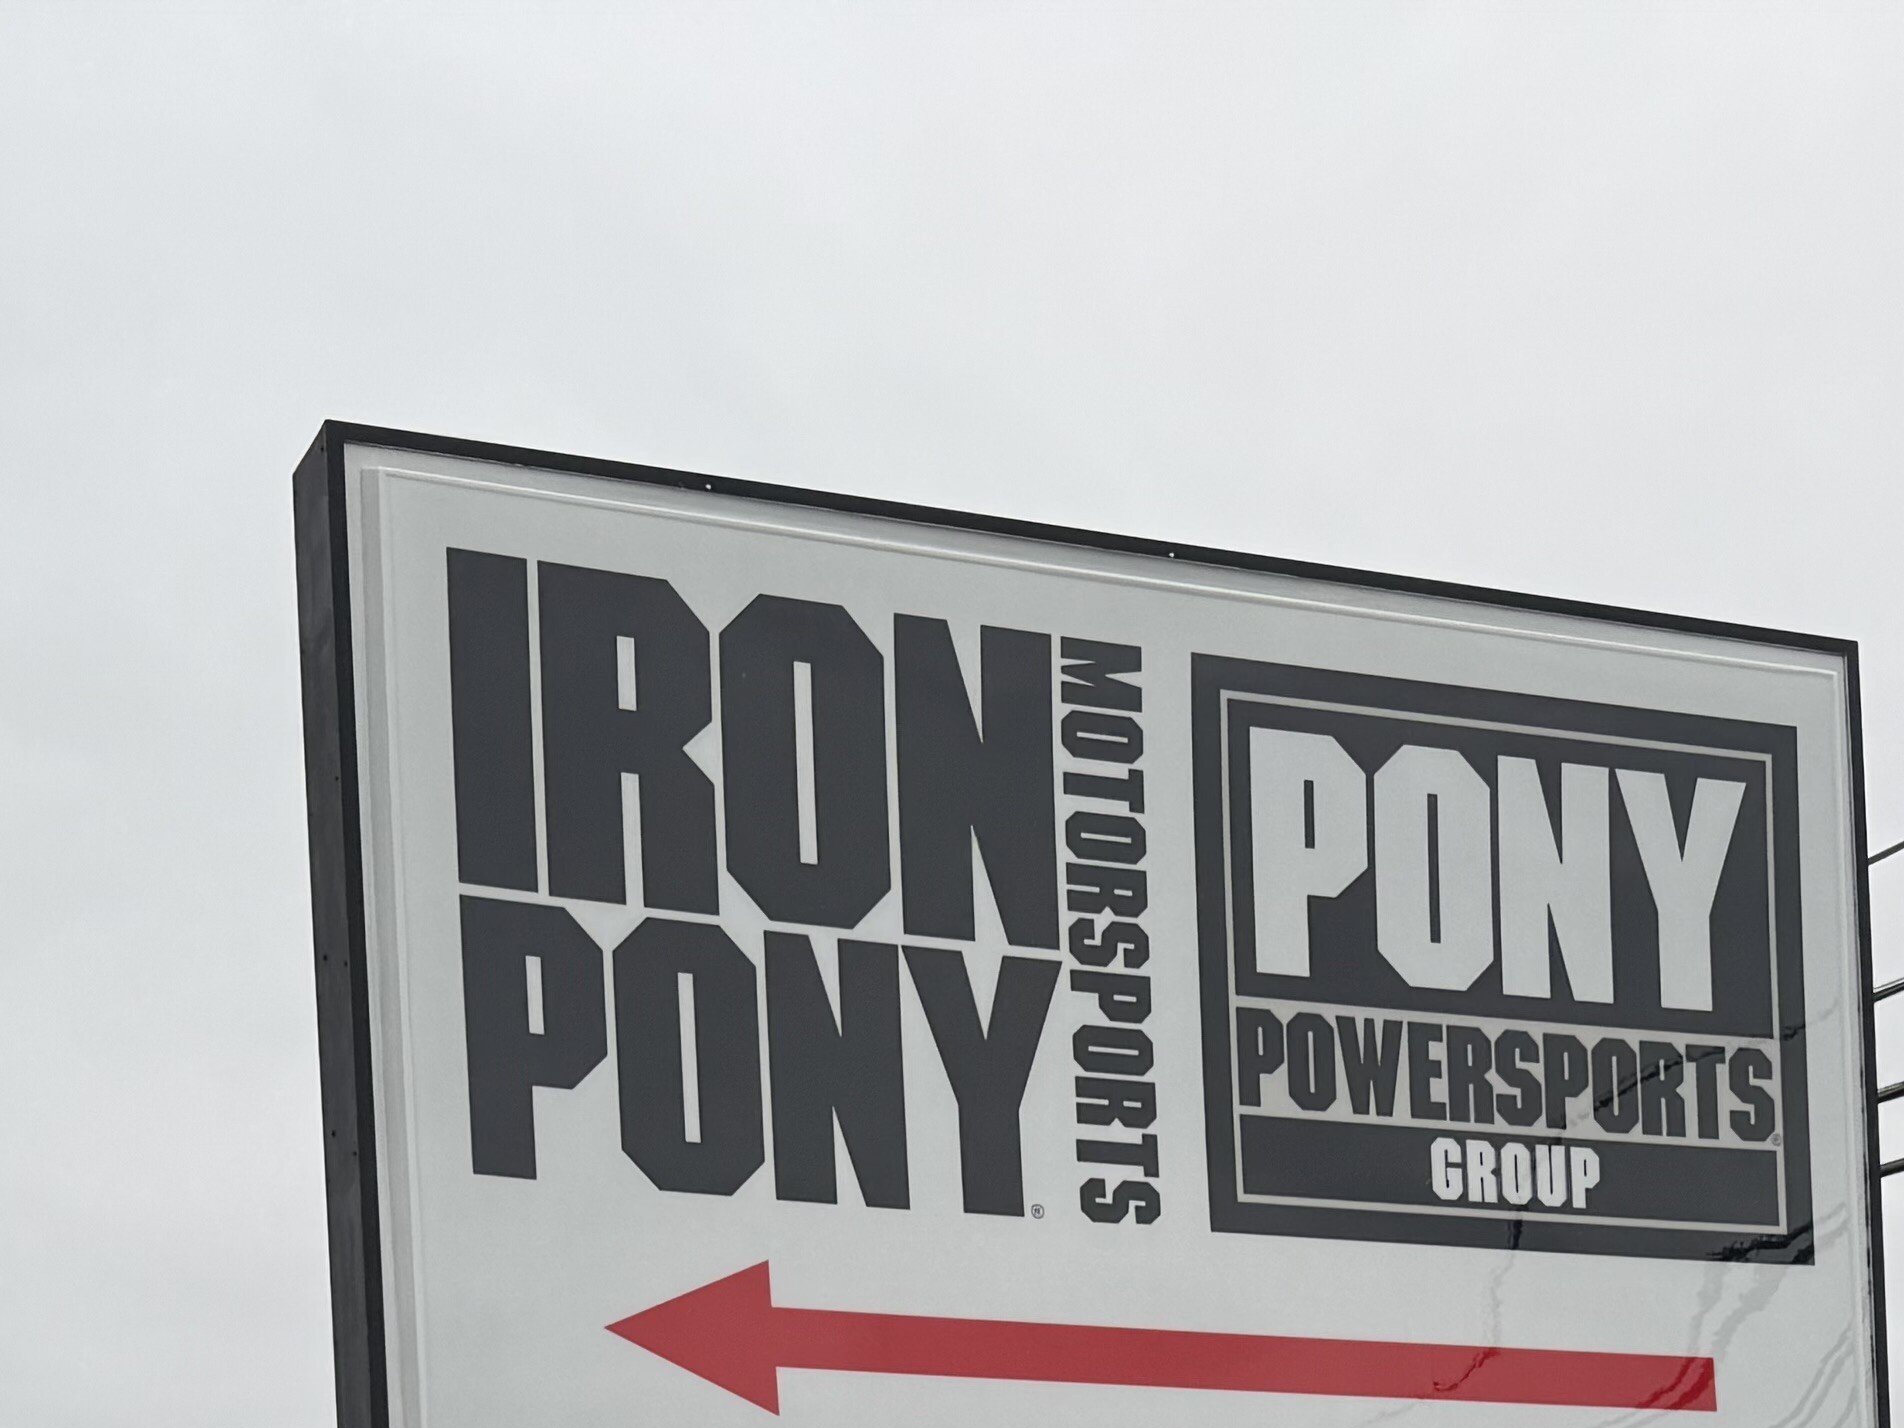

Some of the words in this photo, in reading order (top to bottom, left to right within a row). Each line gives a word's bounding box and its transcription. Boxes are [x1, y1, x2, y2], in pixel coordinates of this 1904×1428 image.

[447, 547, 1062, 950] IRON
[1248, 726, 1748, 1012] PONY
[459, 894, 1063, 1218] PONY
[1058, 636, 1162, 1226] MOTORSPORTS
[1236, 1008, 1776, 1144] POWERSPORTS
[1430, 1136, 1600, 1210] GROUP
